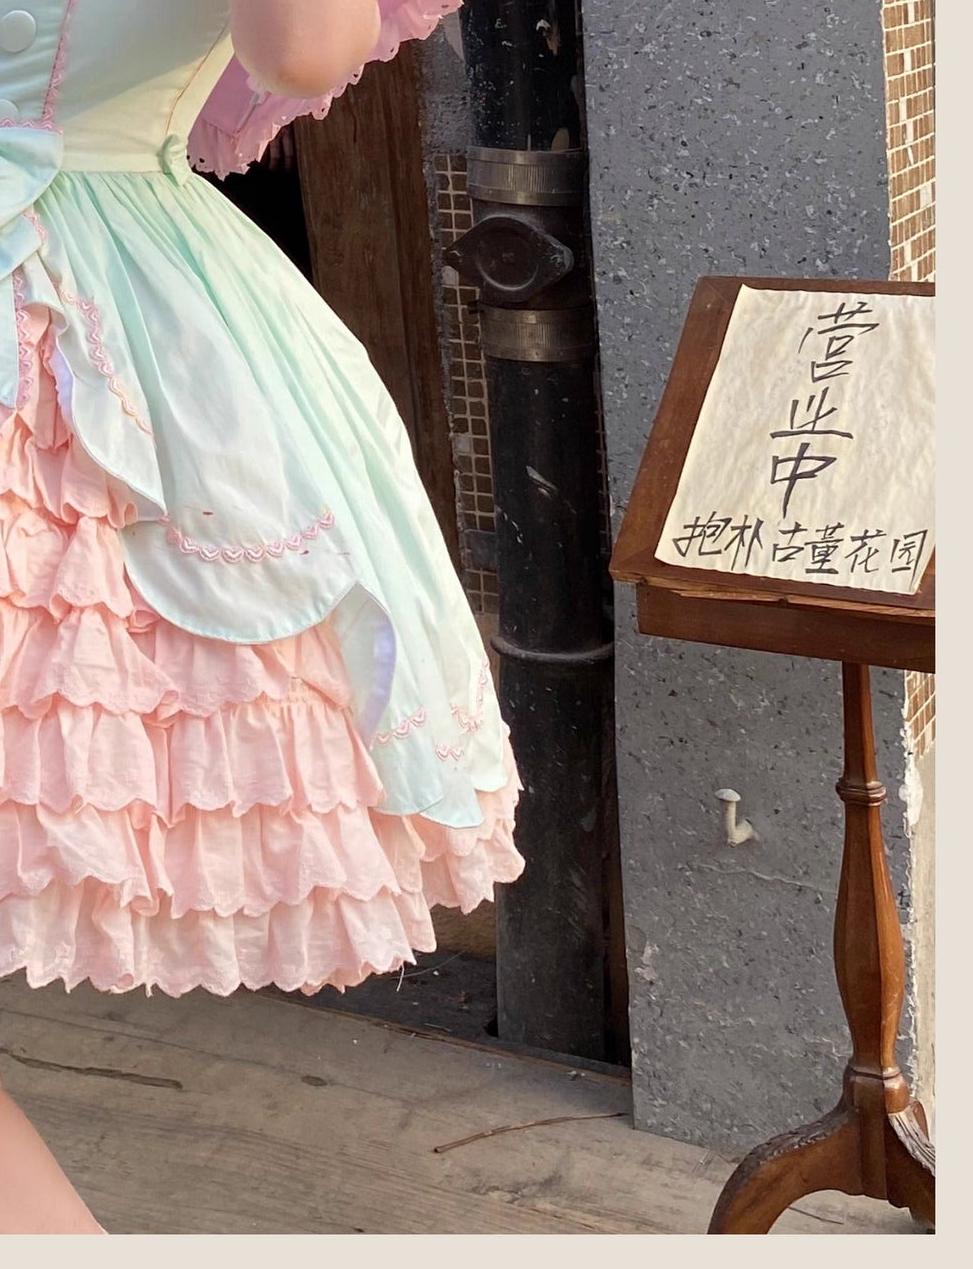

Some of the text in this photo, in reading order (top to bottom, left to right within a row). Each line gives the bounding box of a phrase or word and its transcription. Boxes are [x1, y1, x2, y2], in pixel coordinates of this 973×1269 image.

[770, 301, 880, 520] 营业中
[672, 511, 929, 590] 抱朴古董花园
